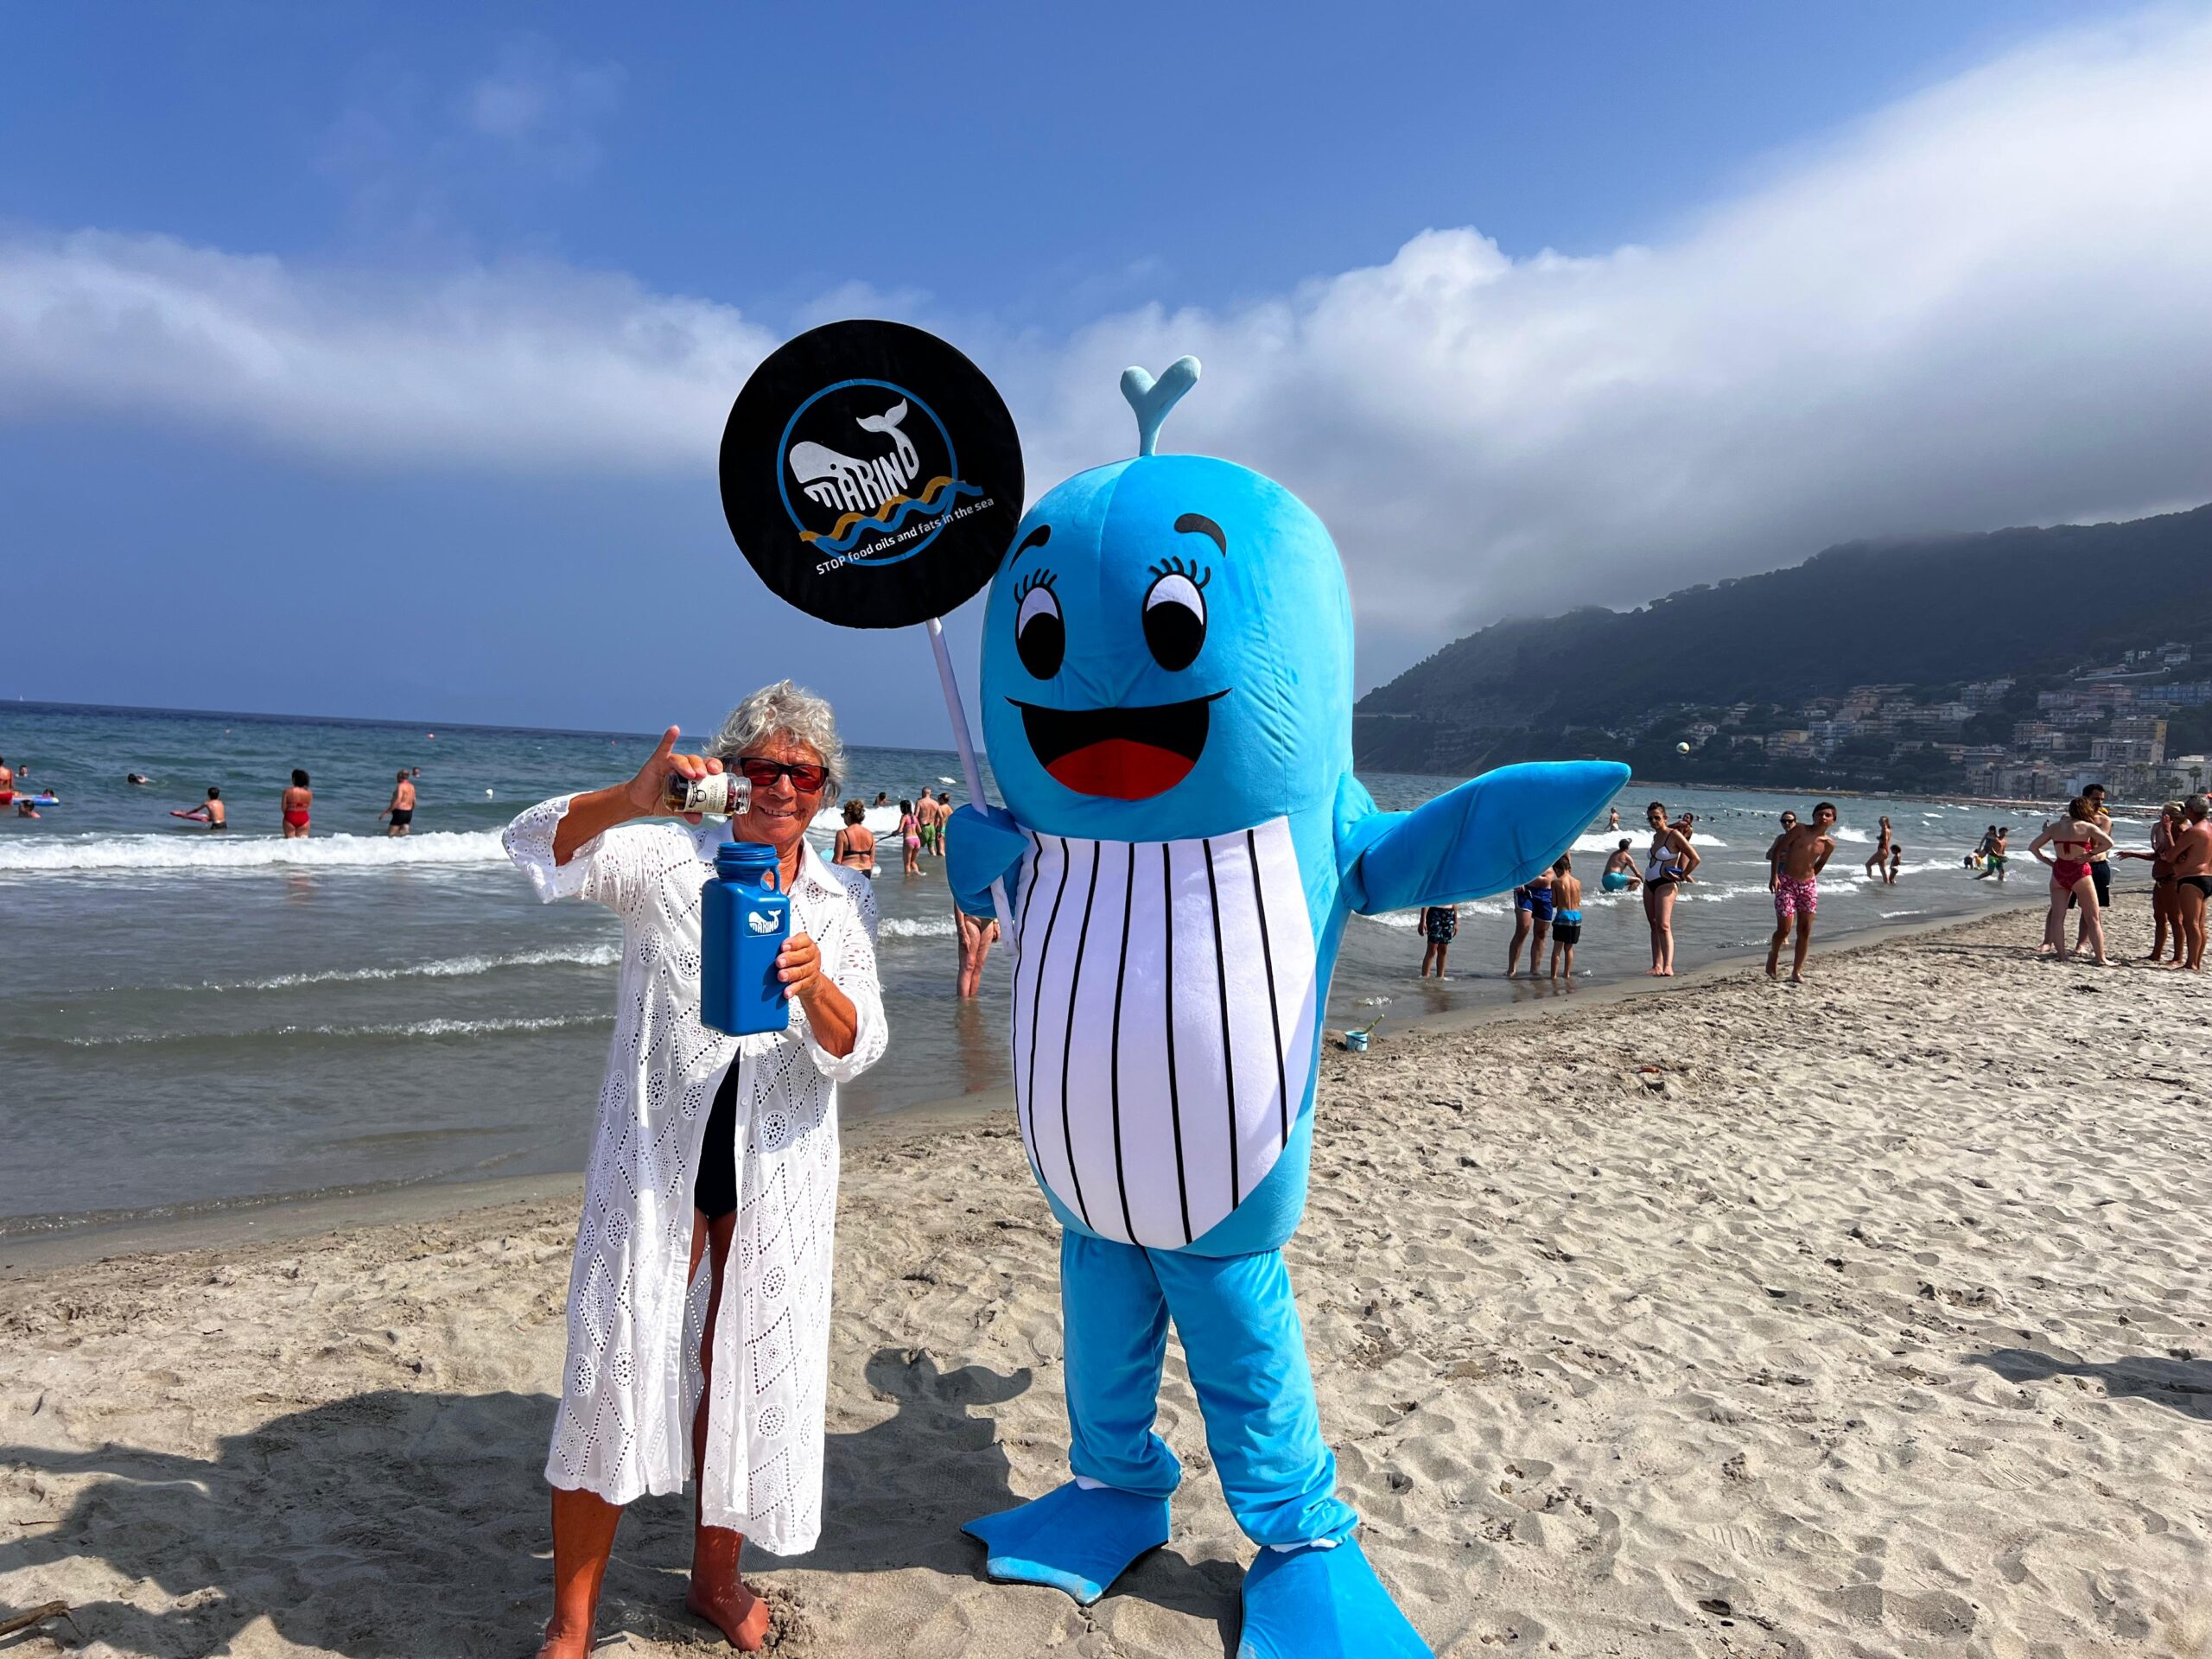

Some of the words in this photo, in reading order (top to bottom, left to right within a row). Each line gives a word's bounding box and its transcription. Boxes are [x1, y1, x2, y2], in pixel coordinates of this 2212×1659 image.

[804, 444, 920, 512] MARINO
[816, 556, 847, 575] STOP
[847, 543, 874, 563] food
[874, 537, 896, 551] oils
[897, 527, 918, 543] and
[918, 519, 942, 535] fats
[942, 512, 954, 524] in
[954, 504, 974, 519] the
[974, 497, 995, 512] sea
[749, 918, 779, 934] MARINO
